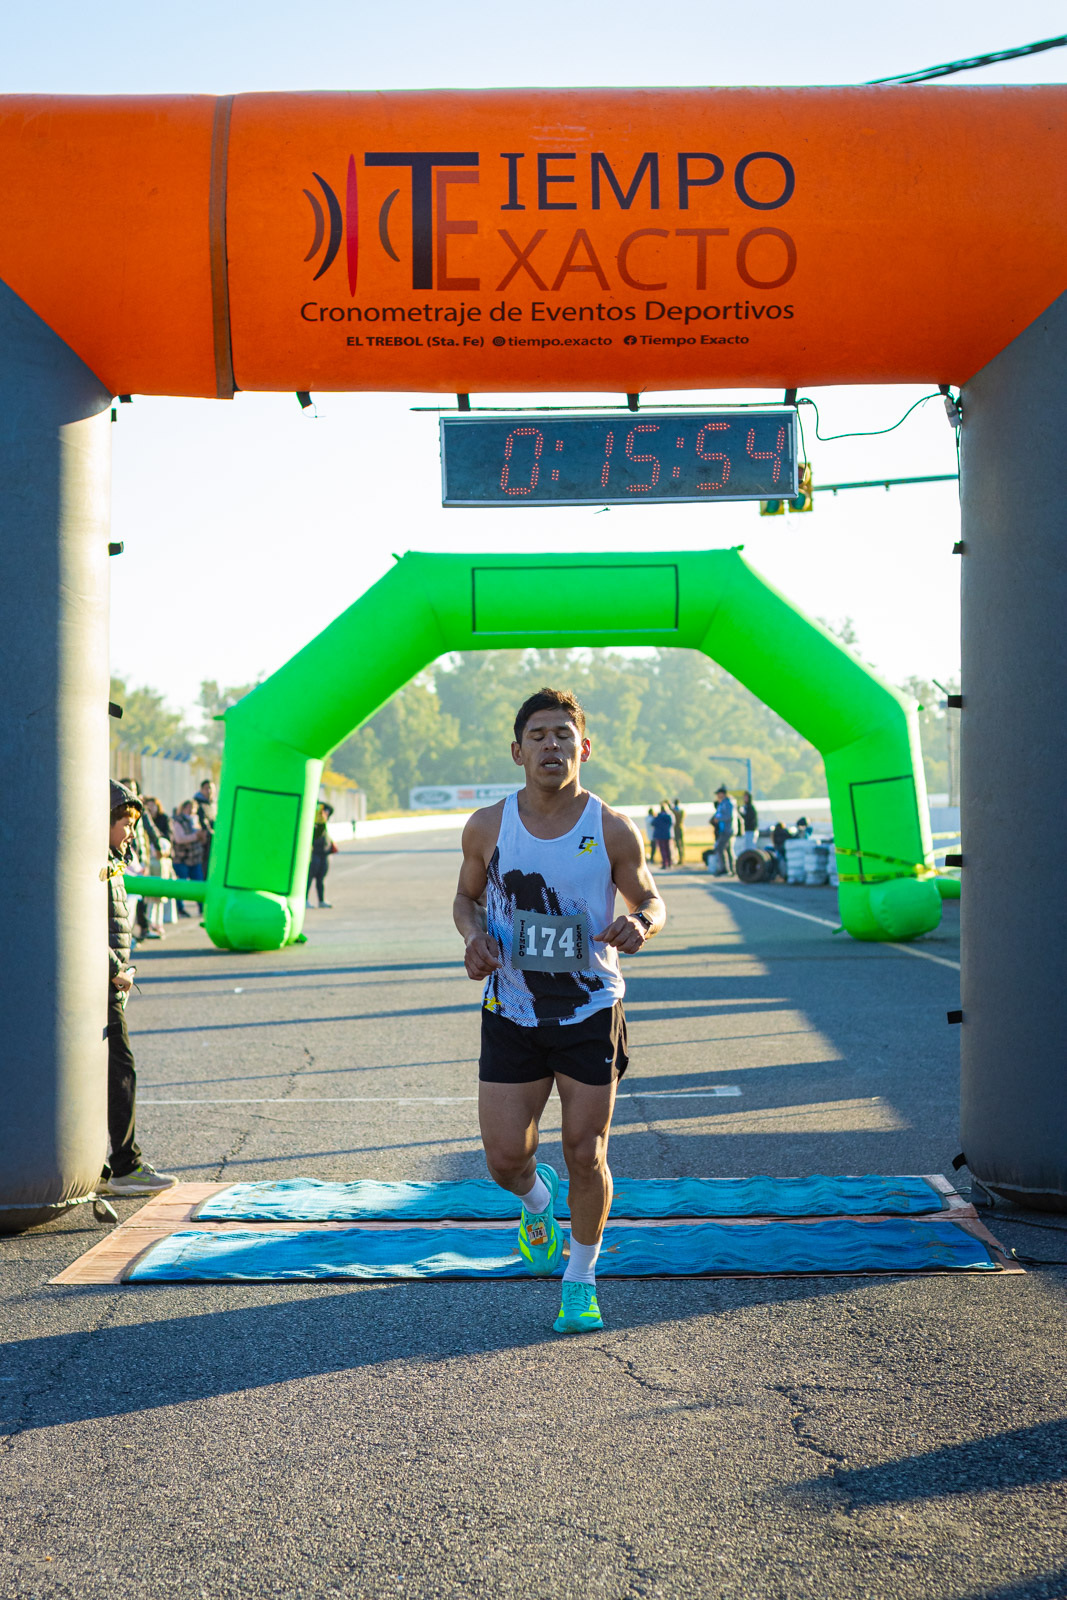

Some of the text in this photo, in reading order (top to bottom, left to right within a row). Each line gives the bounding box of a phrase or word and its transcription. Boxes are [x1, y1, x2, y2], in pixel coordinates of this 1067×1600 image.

[300, 300, 795, 327] Cronometraje de Eventos Deportivos
[346, 335, 613, 349] EL TREBOL (Sta. Fe) tiempo.exacto
[639, 334, 750, 347] Tiempo Exacto
[526, 925, 575, 957] 174
